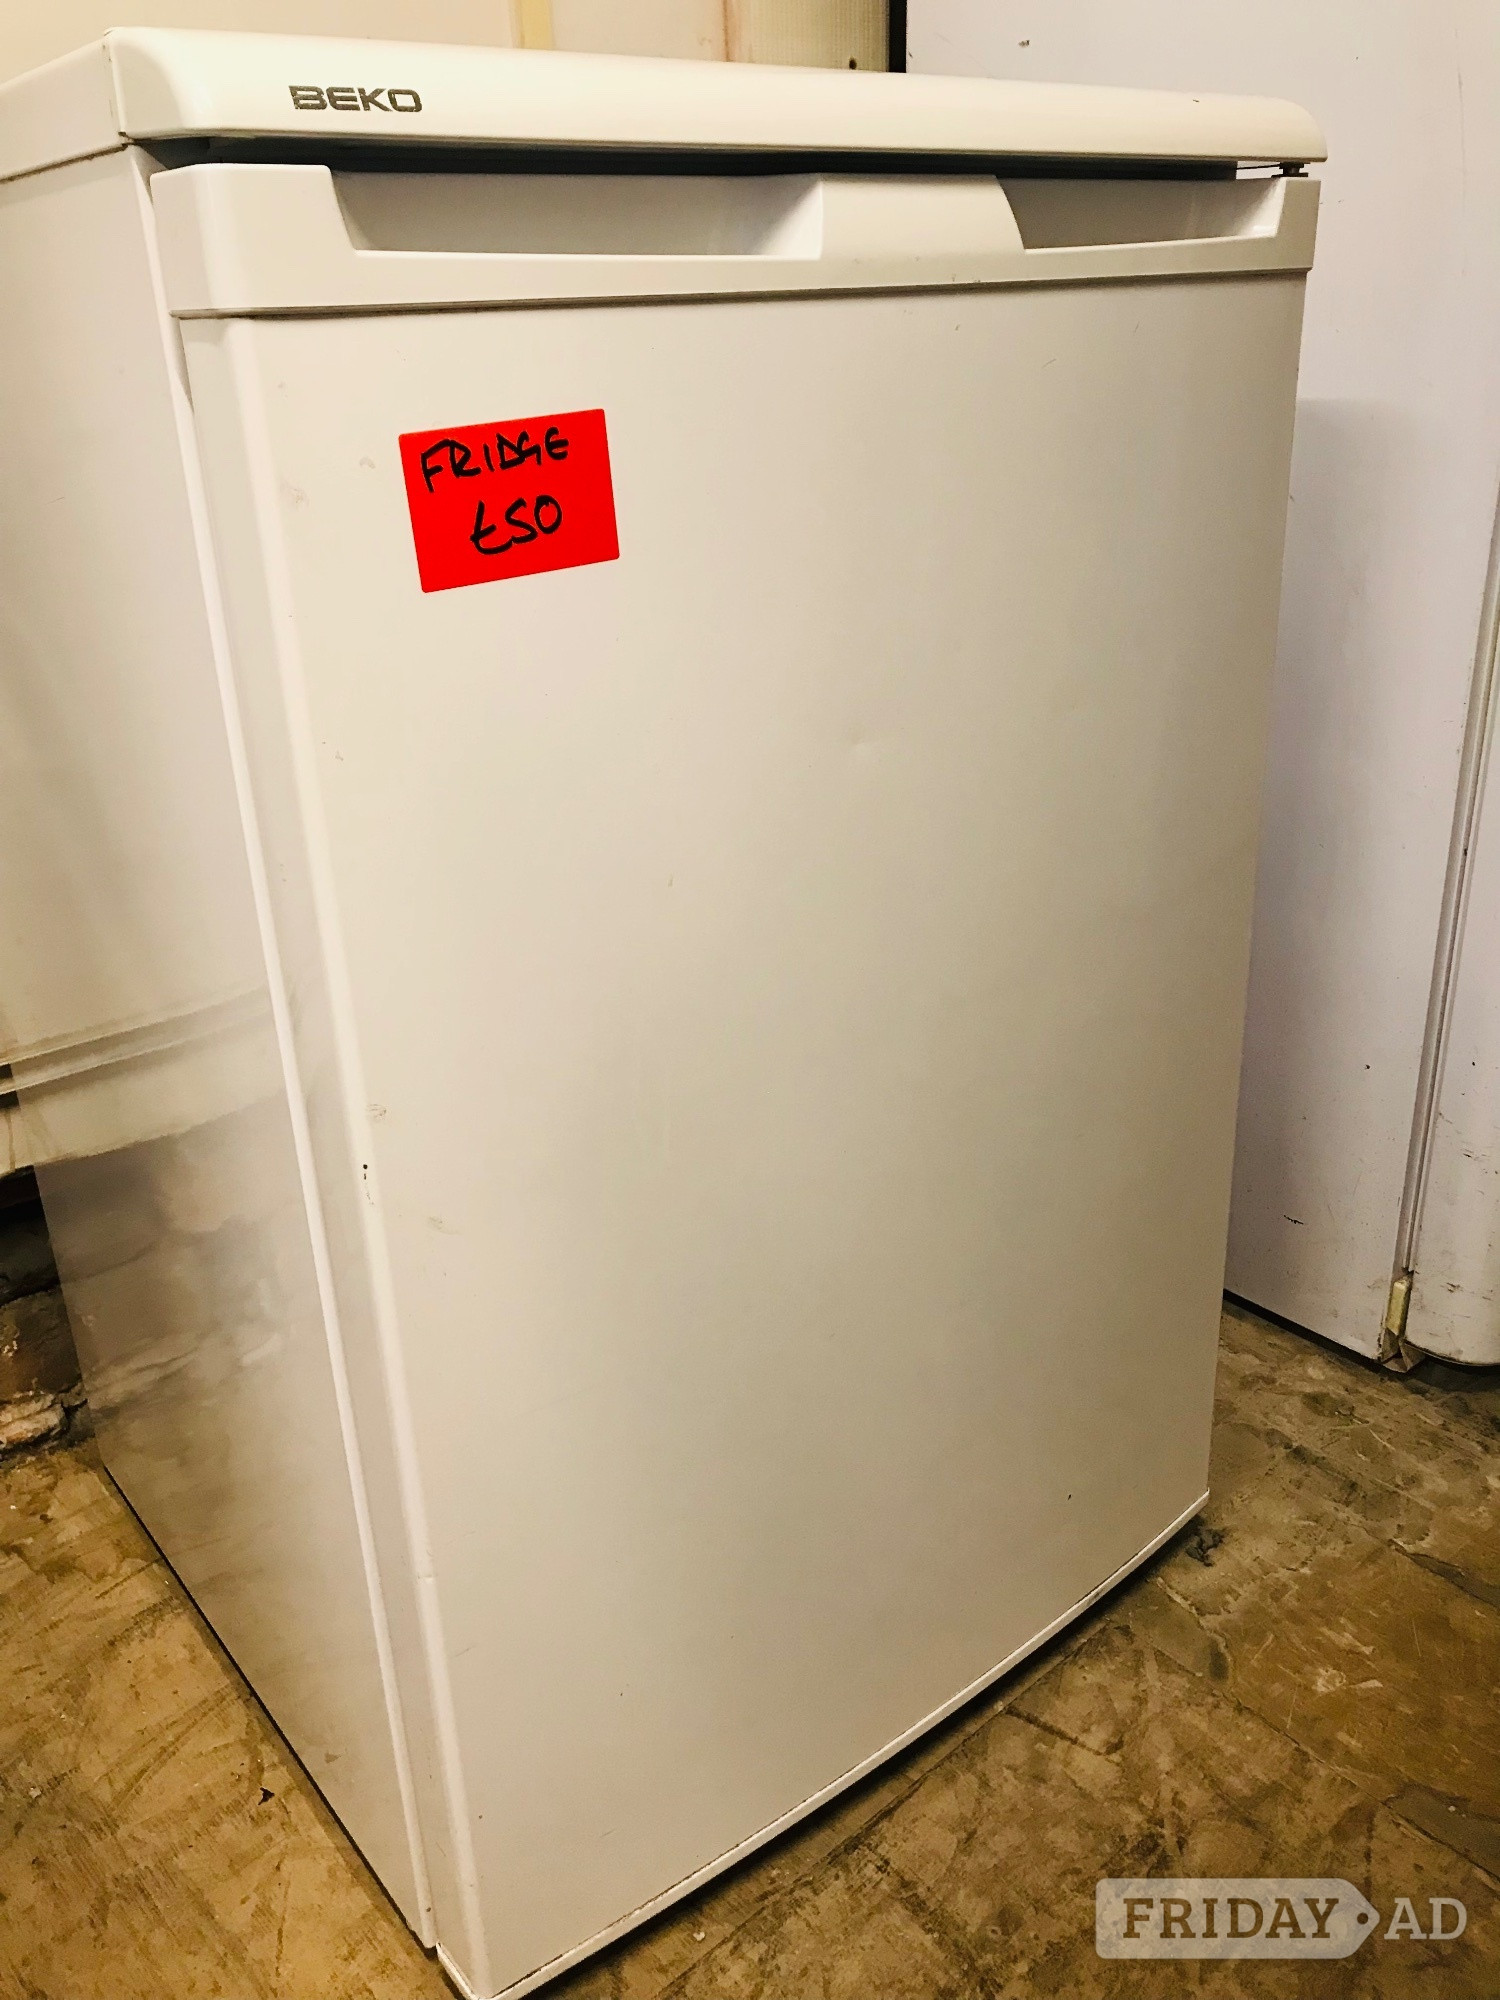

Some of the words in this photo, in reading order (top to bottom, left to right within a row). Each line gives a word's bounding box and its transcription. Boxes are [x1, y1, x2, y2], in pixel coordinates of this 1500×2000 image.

[288, 85, 423, 113] BEKO
[420, 426, 570, 493] FRIDGE
[469, 494, 563, 556] £50
